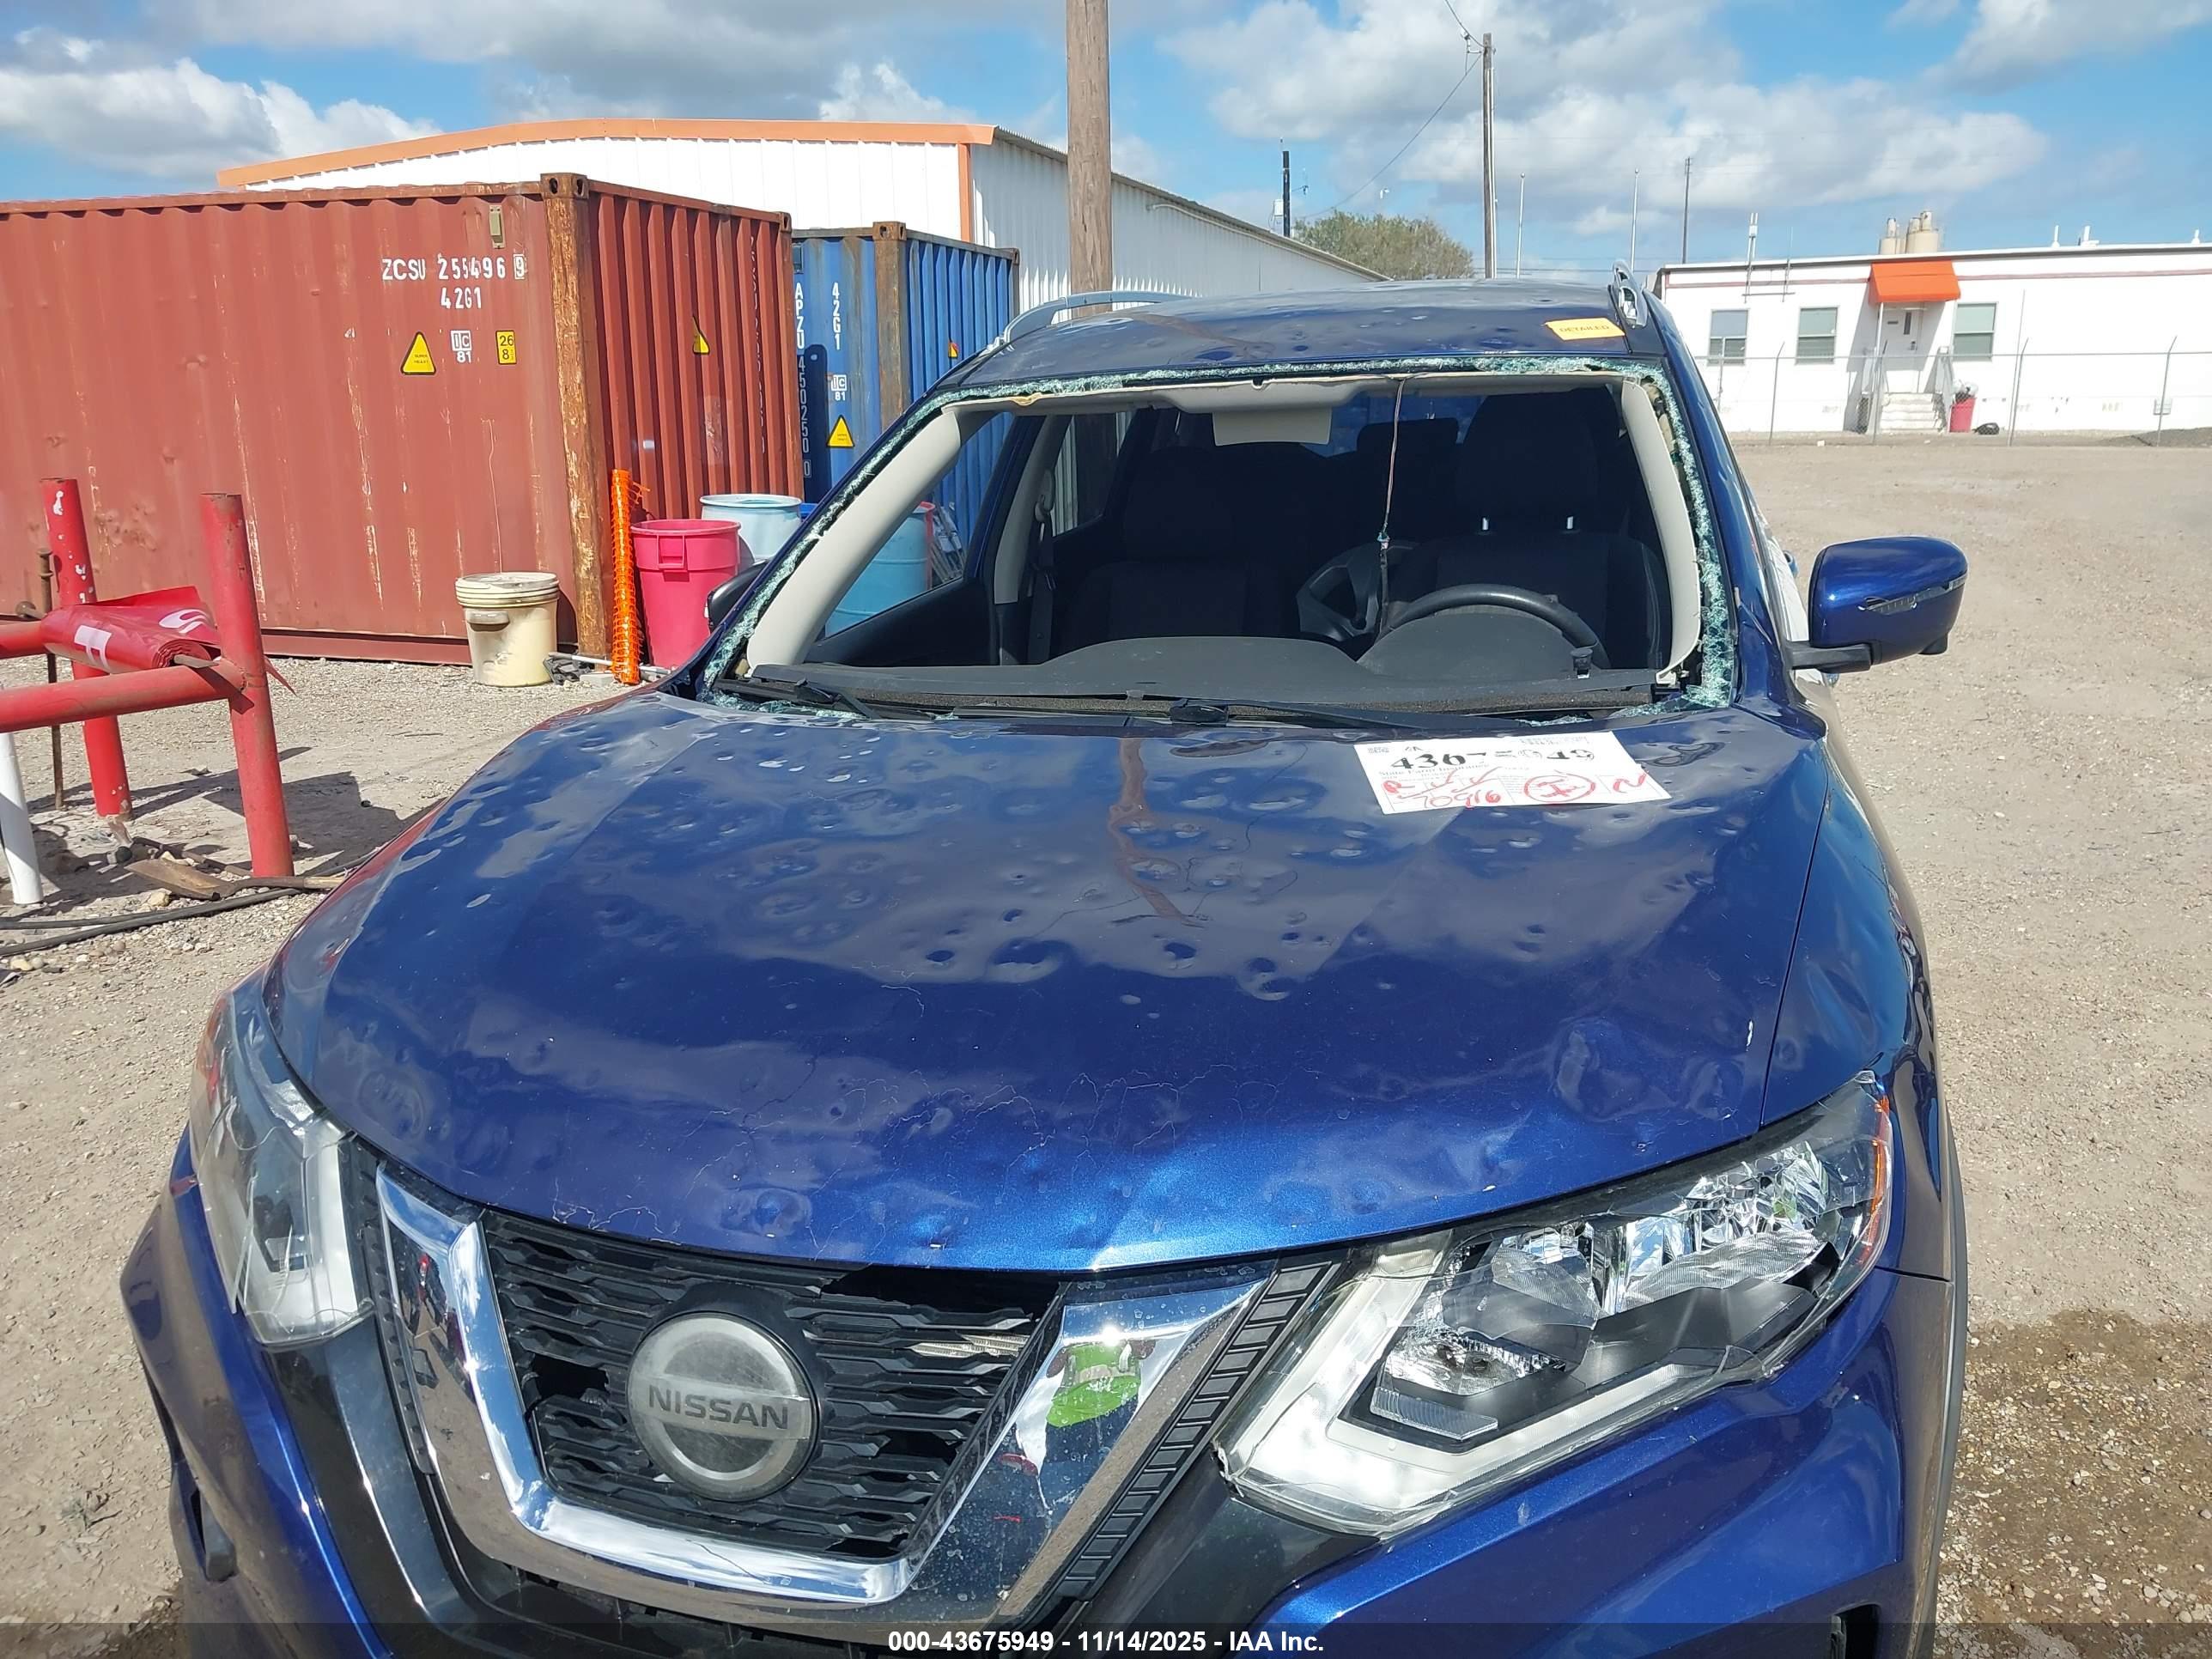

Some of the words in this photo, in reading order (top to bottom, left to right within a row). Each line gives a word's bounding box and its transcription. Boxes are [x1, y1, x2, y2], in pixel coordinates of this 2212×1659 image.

[381, 258, 426, 281] ZCSU
[437, 256, 507, 280] 255496
[441, 286, 483, 310] 42G1
[794, 282, 805, 349] APZU
[831, 282, 842, 350] 42G1
[499, 334, 514, 347] 26
[456, 350, 472, 364] 81
[798, 355, 810, 453] 450250
[835, 392, 846, 402] 81
[648, 1384, 788, 1430] NISSAN
